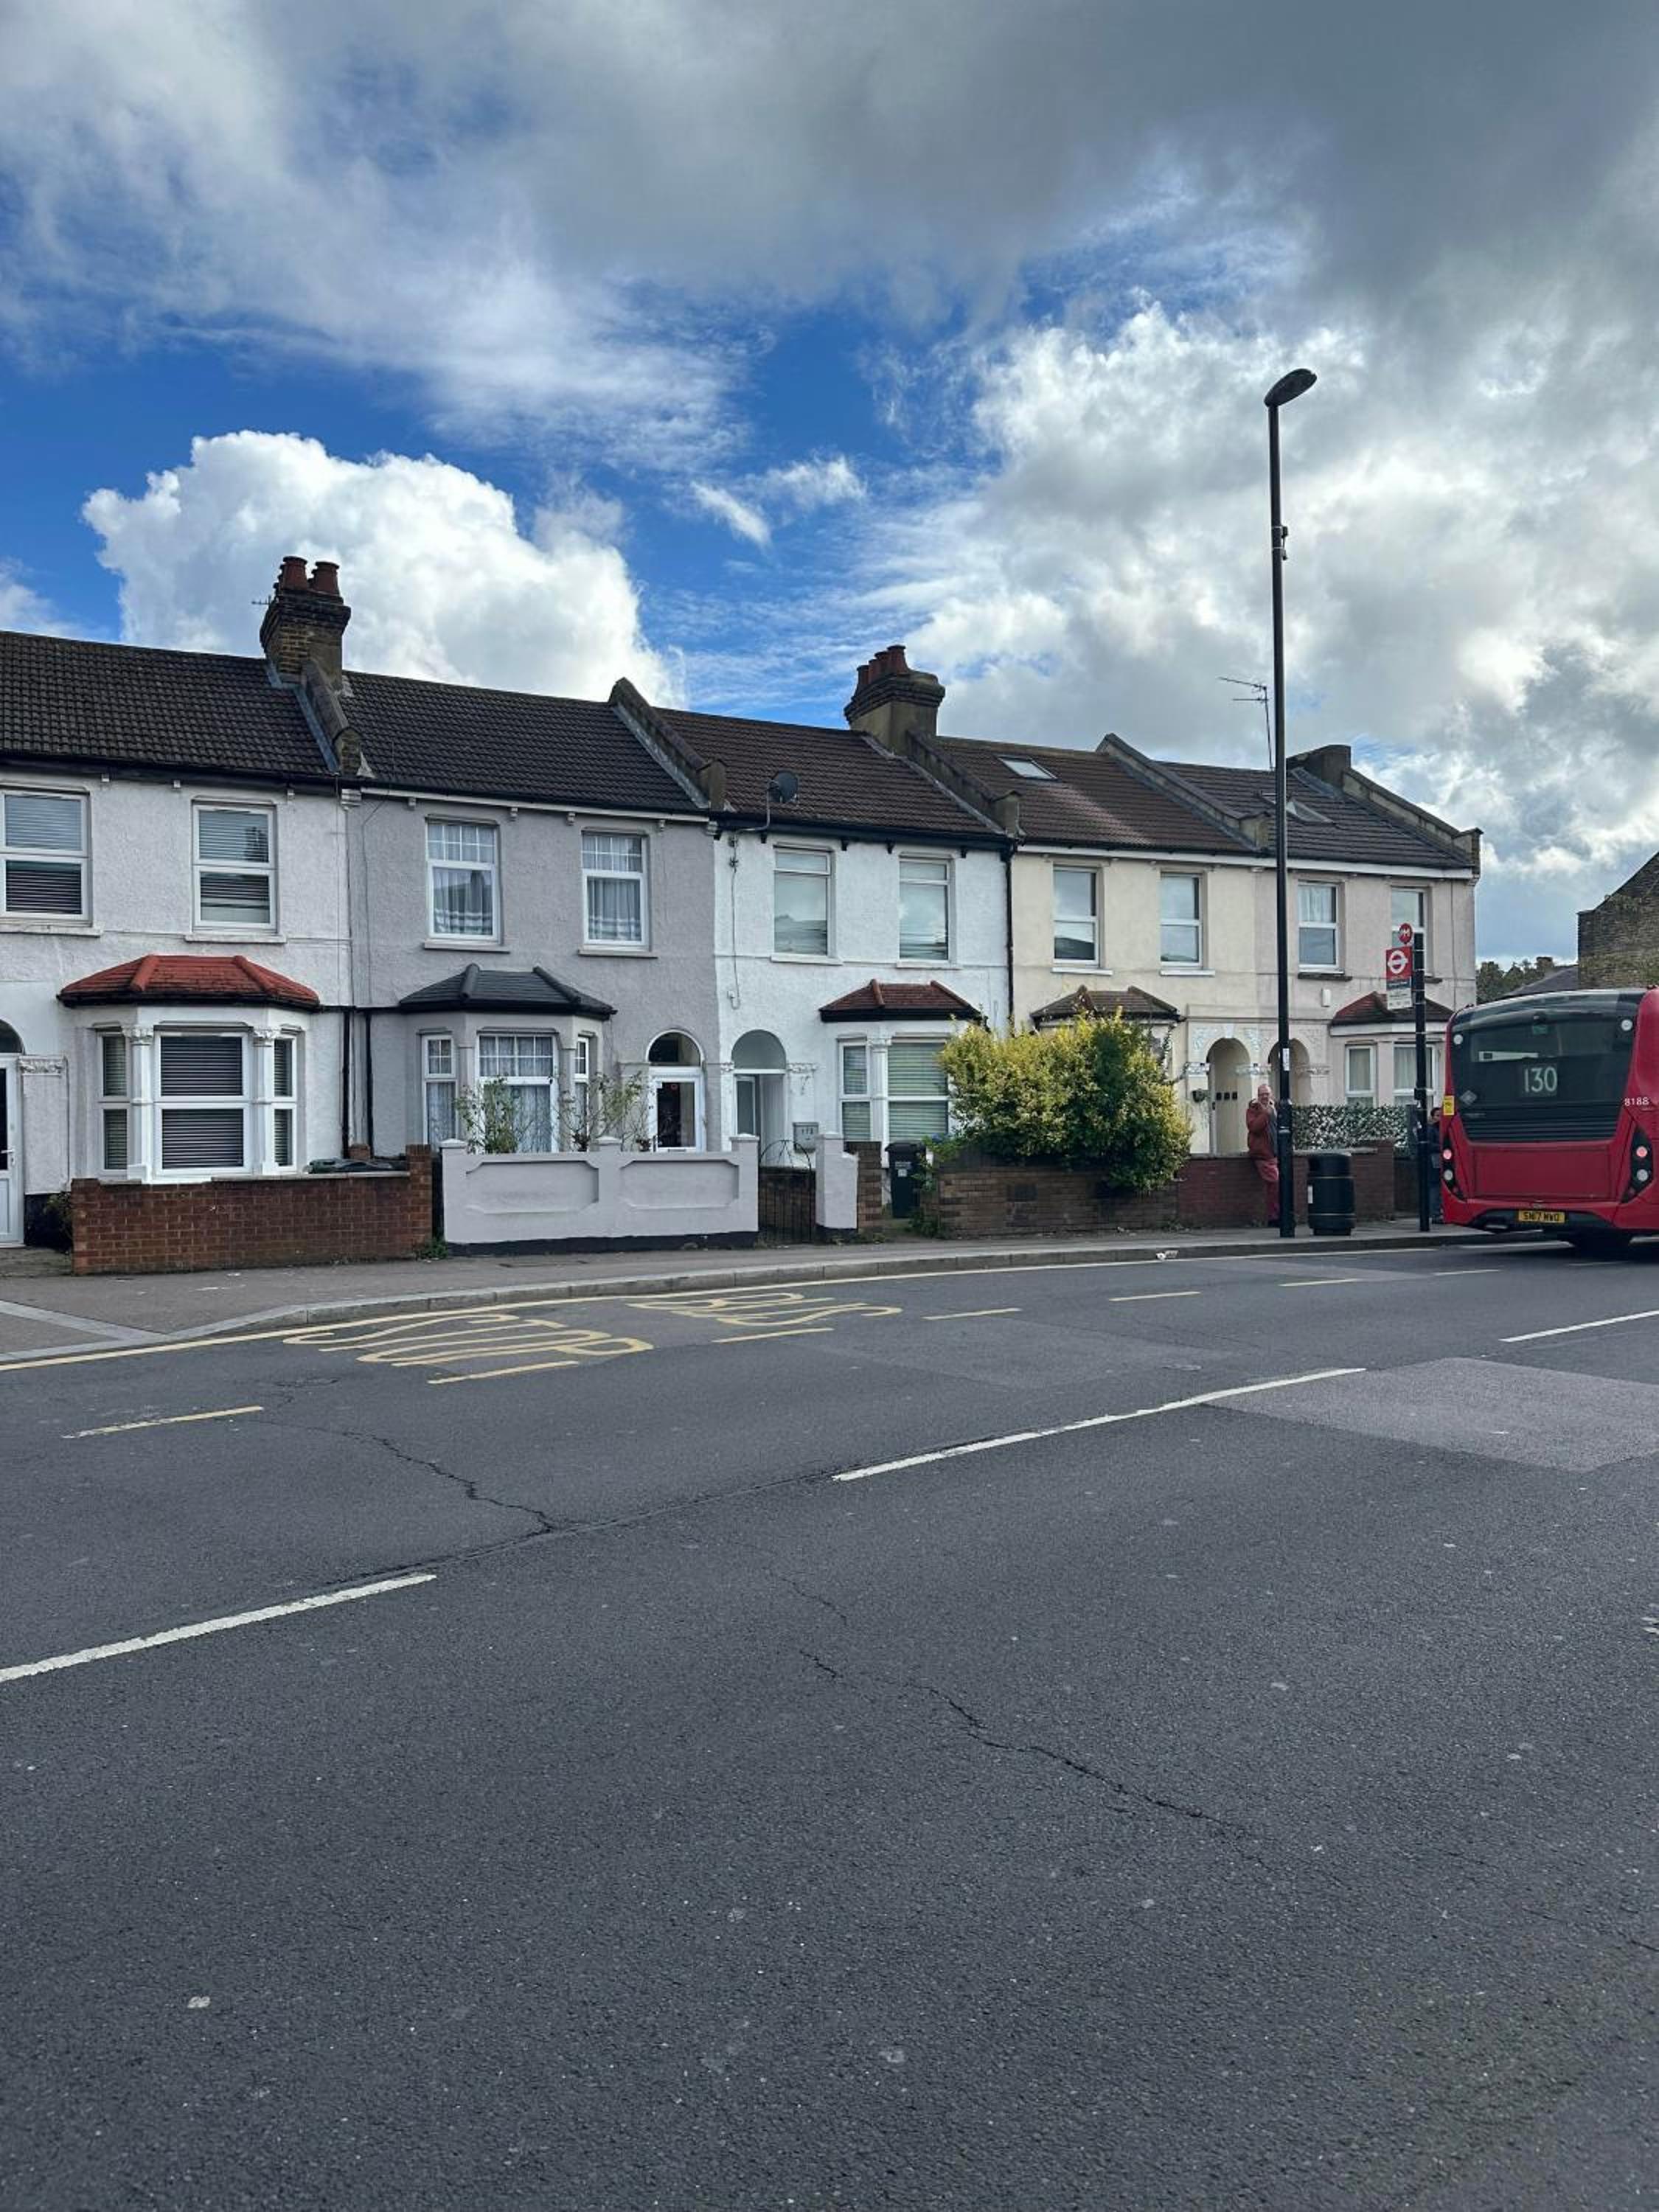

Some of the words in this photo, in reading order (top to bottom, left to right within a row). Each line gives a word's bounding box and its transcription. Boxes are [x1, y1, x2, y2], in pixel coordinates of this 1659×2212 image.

[1524, 1066, 1557, 1093] 130
[625, 1292, 902, 1326] BUS
[283, 1313, 654, 1367] STOP
